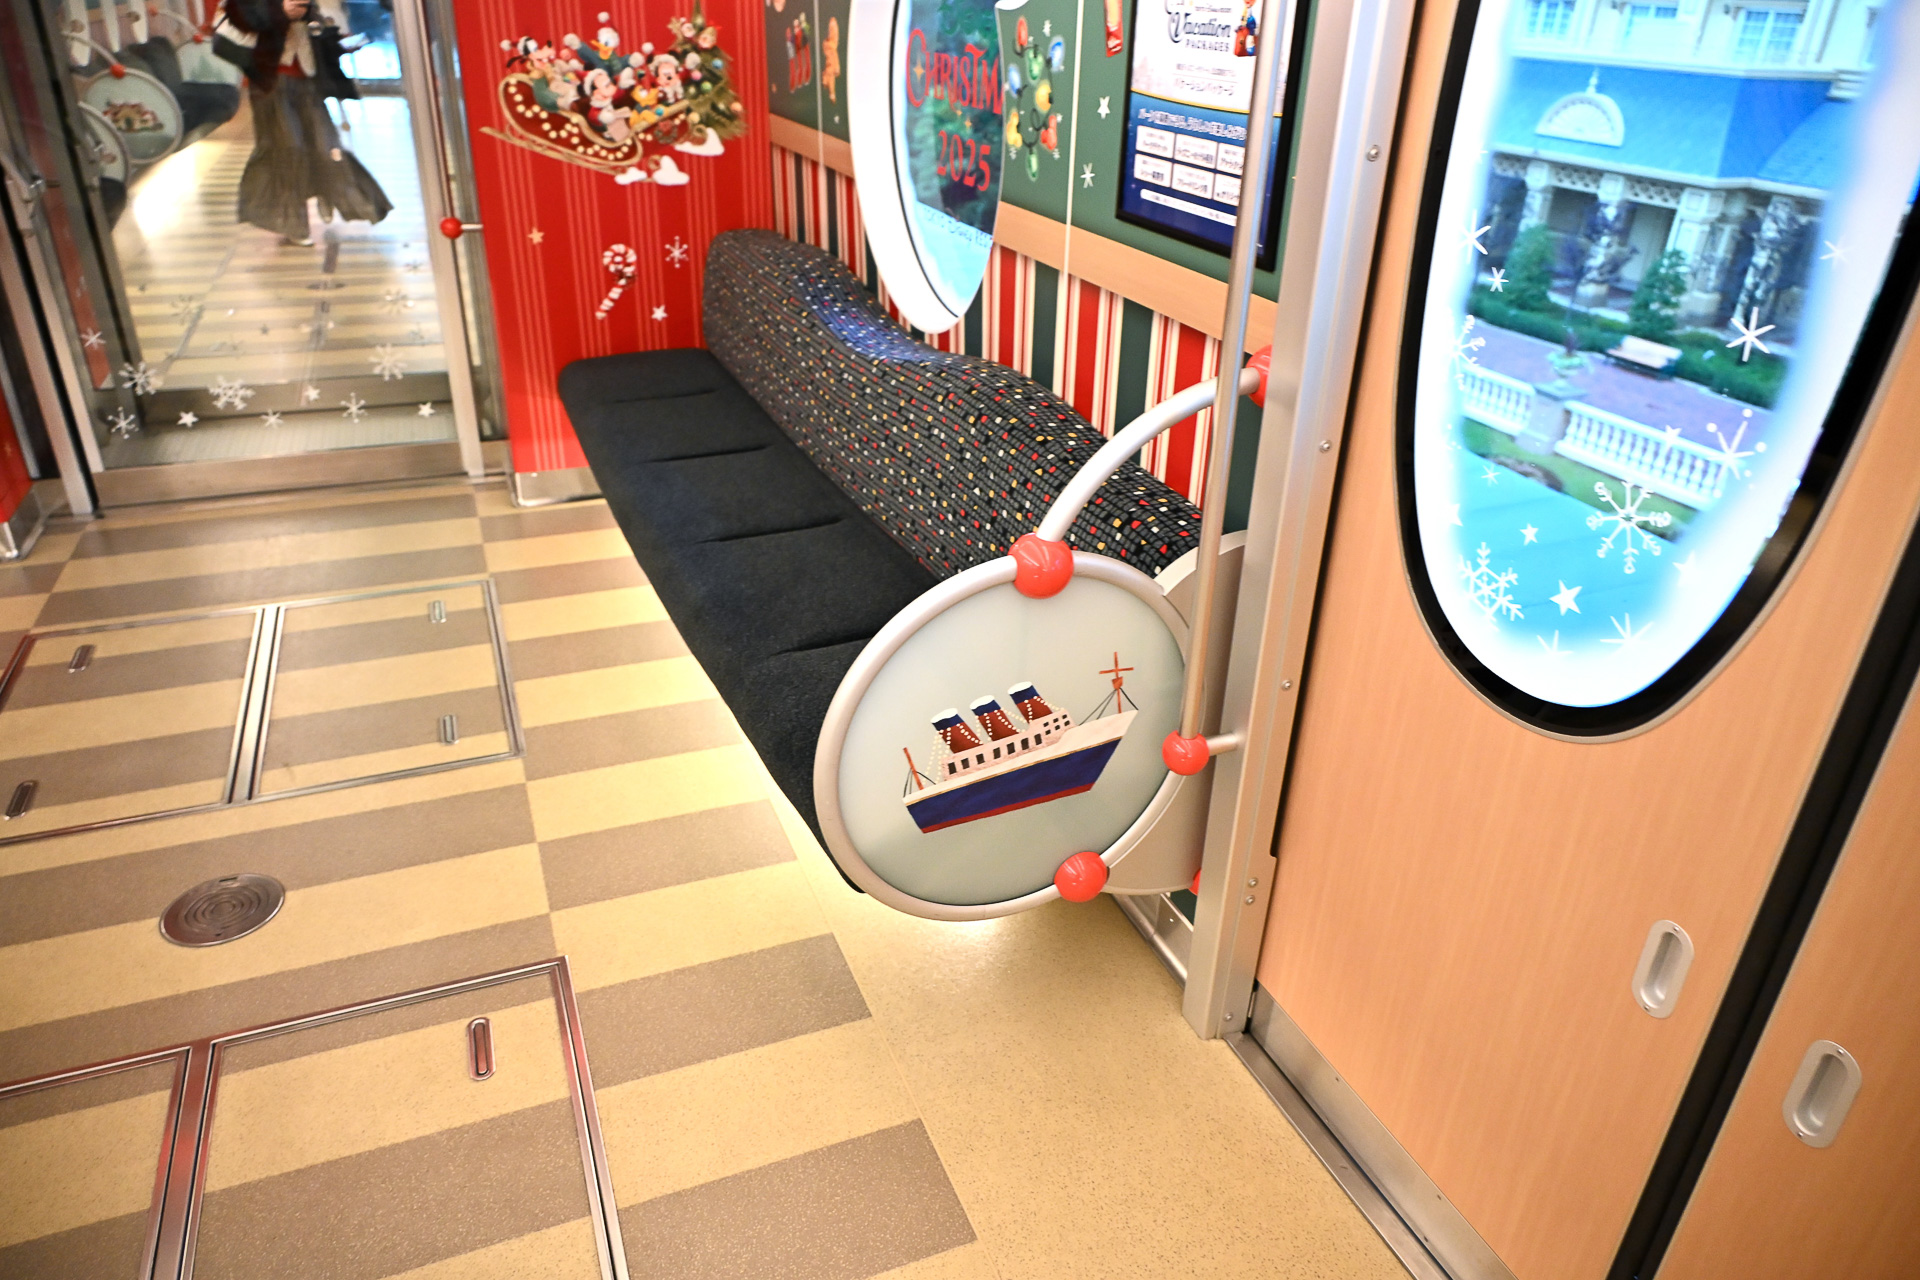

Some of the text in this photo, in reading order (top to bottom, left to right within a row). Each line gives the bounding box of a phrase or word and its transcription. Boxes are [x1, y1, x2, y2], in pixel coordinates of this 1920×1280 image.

[1168, 12, 1231, 43] Vacation
[906, 28, 1004, 115] CHRISTM
[937, 130, 991, 191] 2025
